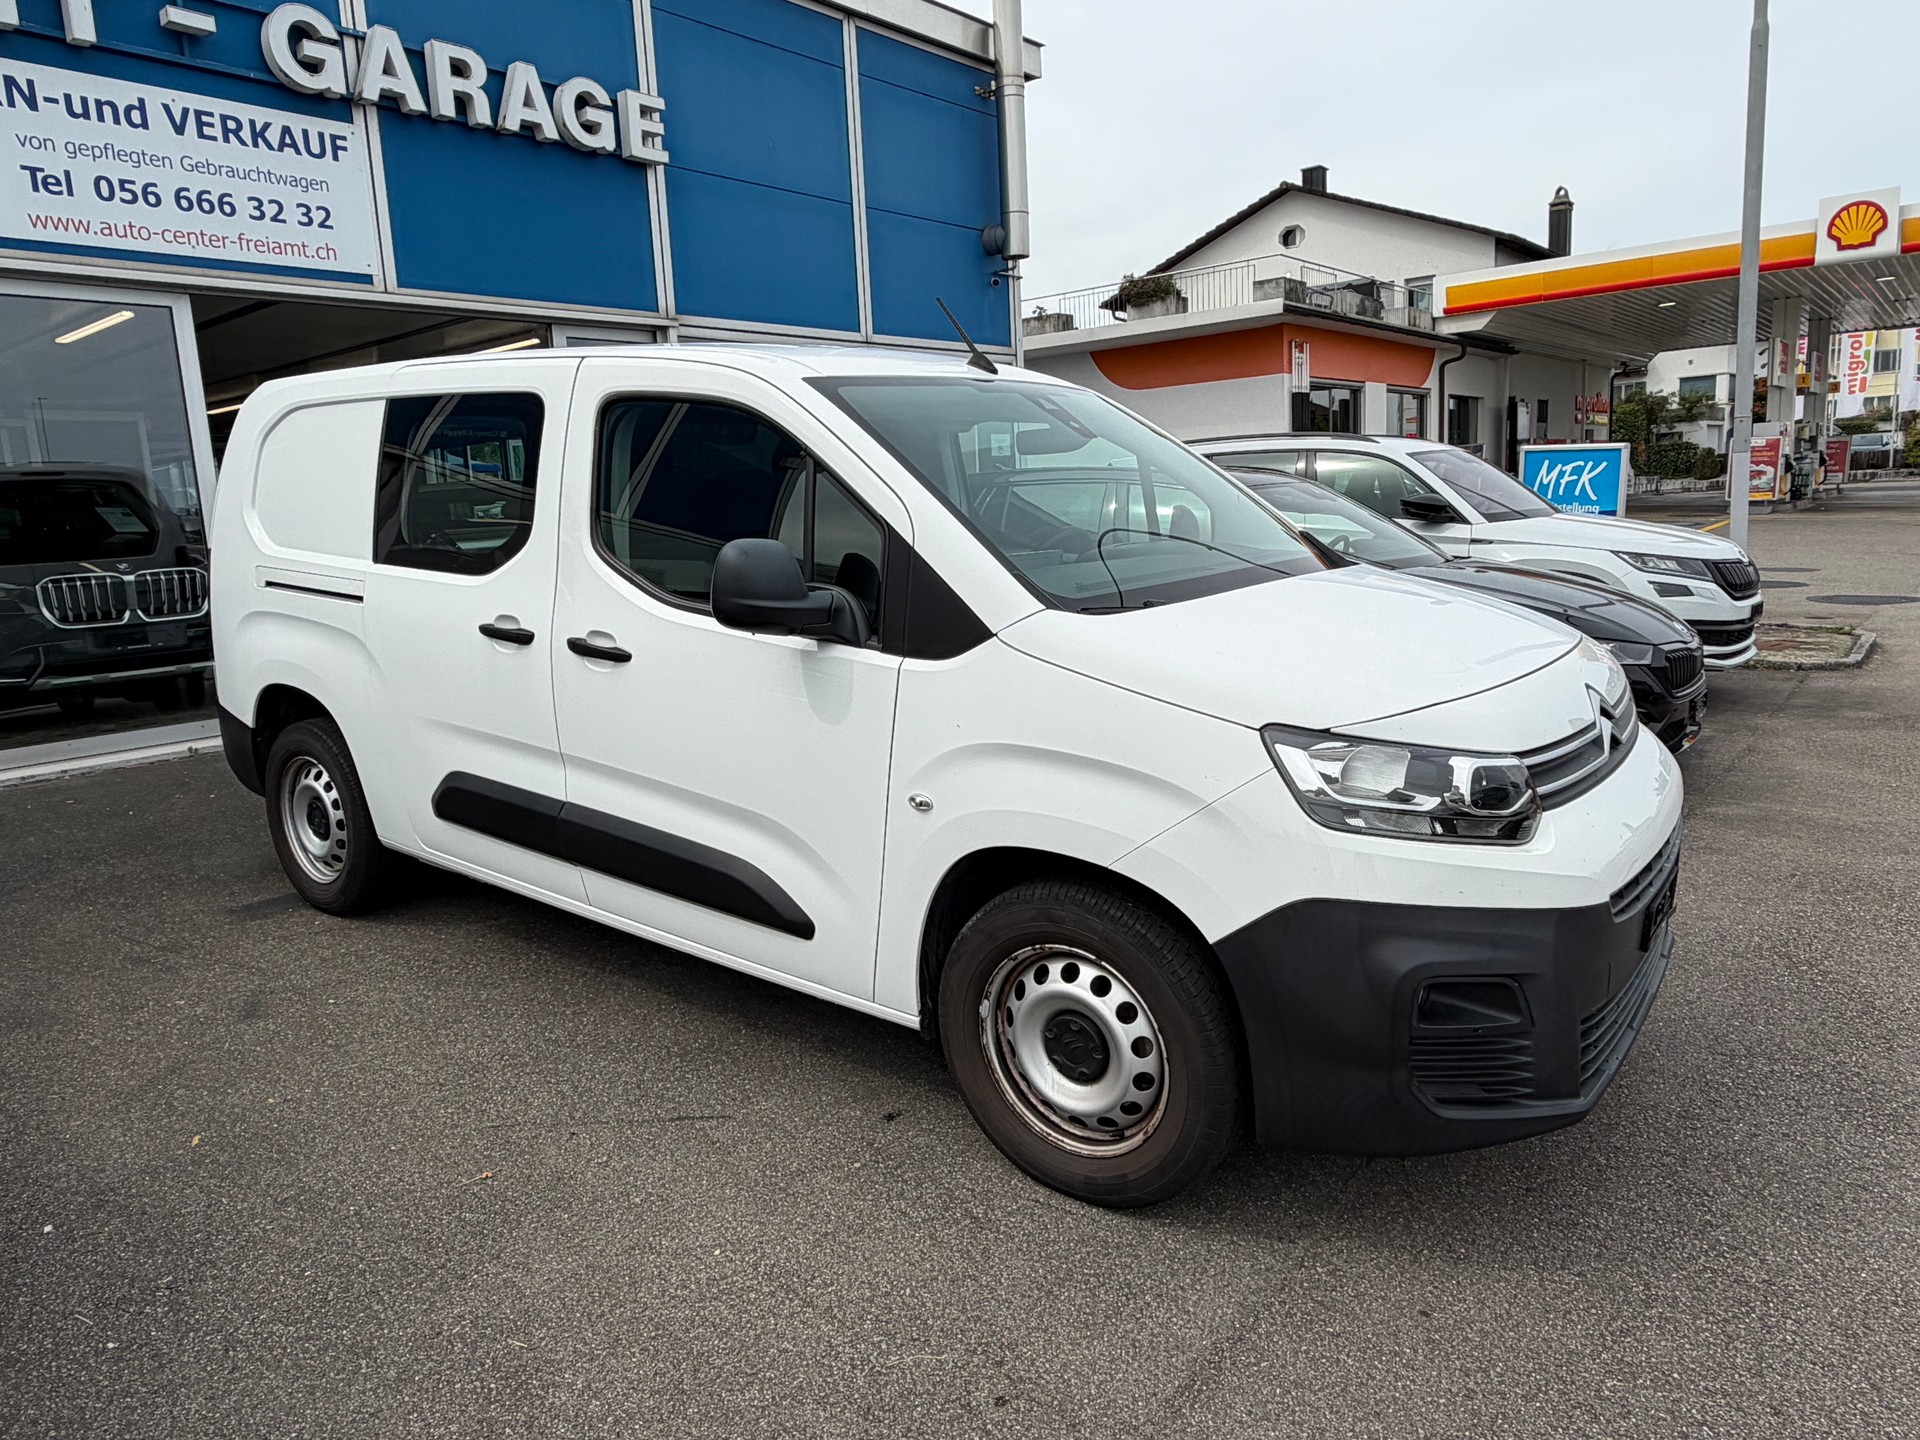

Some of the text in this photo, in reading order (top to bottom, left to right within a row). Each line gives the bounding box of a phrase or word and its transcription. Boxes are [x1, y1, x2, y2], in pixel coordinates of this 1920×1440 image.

[261, 2, 669, 165] GARAGE
[0, 73, 349, 163] N-und VERKAUF
[15, 133, 330, 193] von gepflegten Gebrauchtwagen
[19, 164, 335, 231] Tel 056 666 32 32
[27, 212, 338, 261] www.auto-center-freiamt.ch
[1533, 459, 1608, 501] MFK
